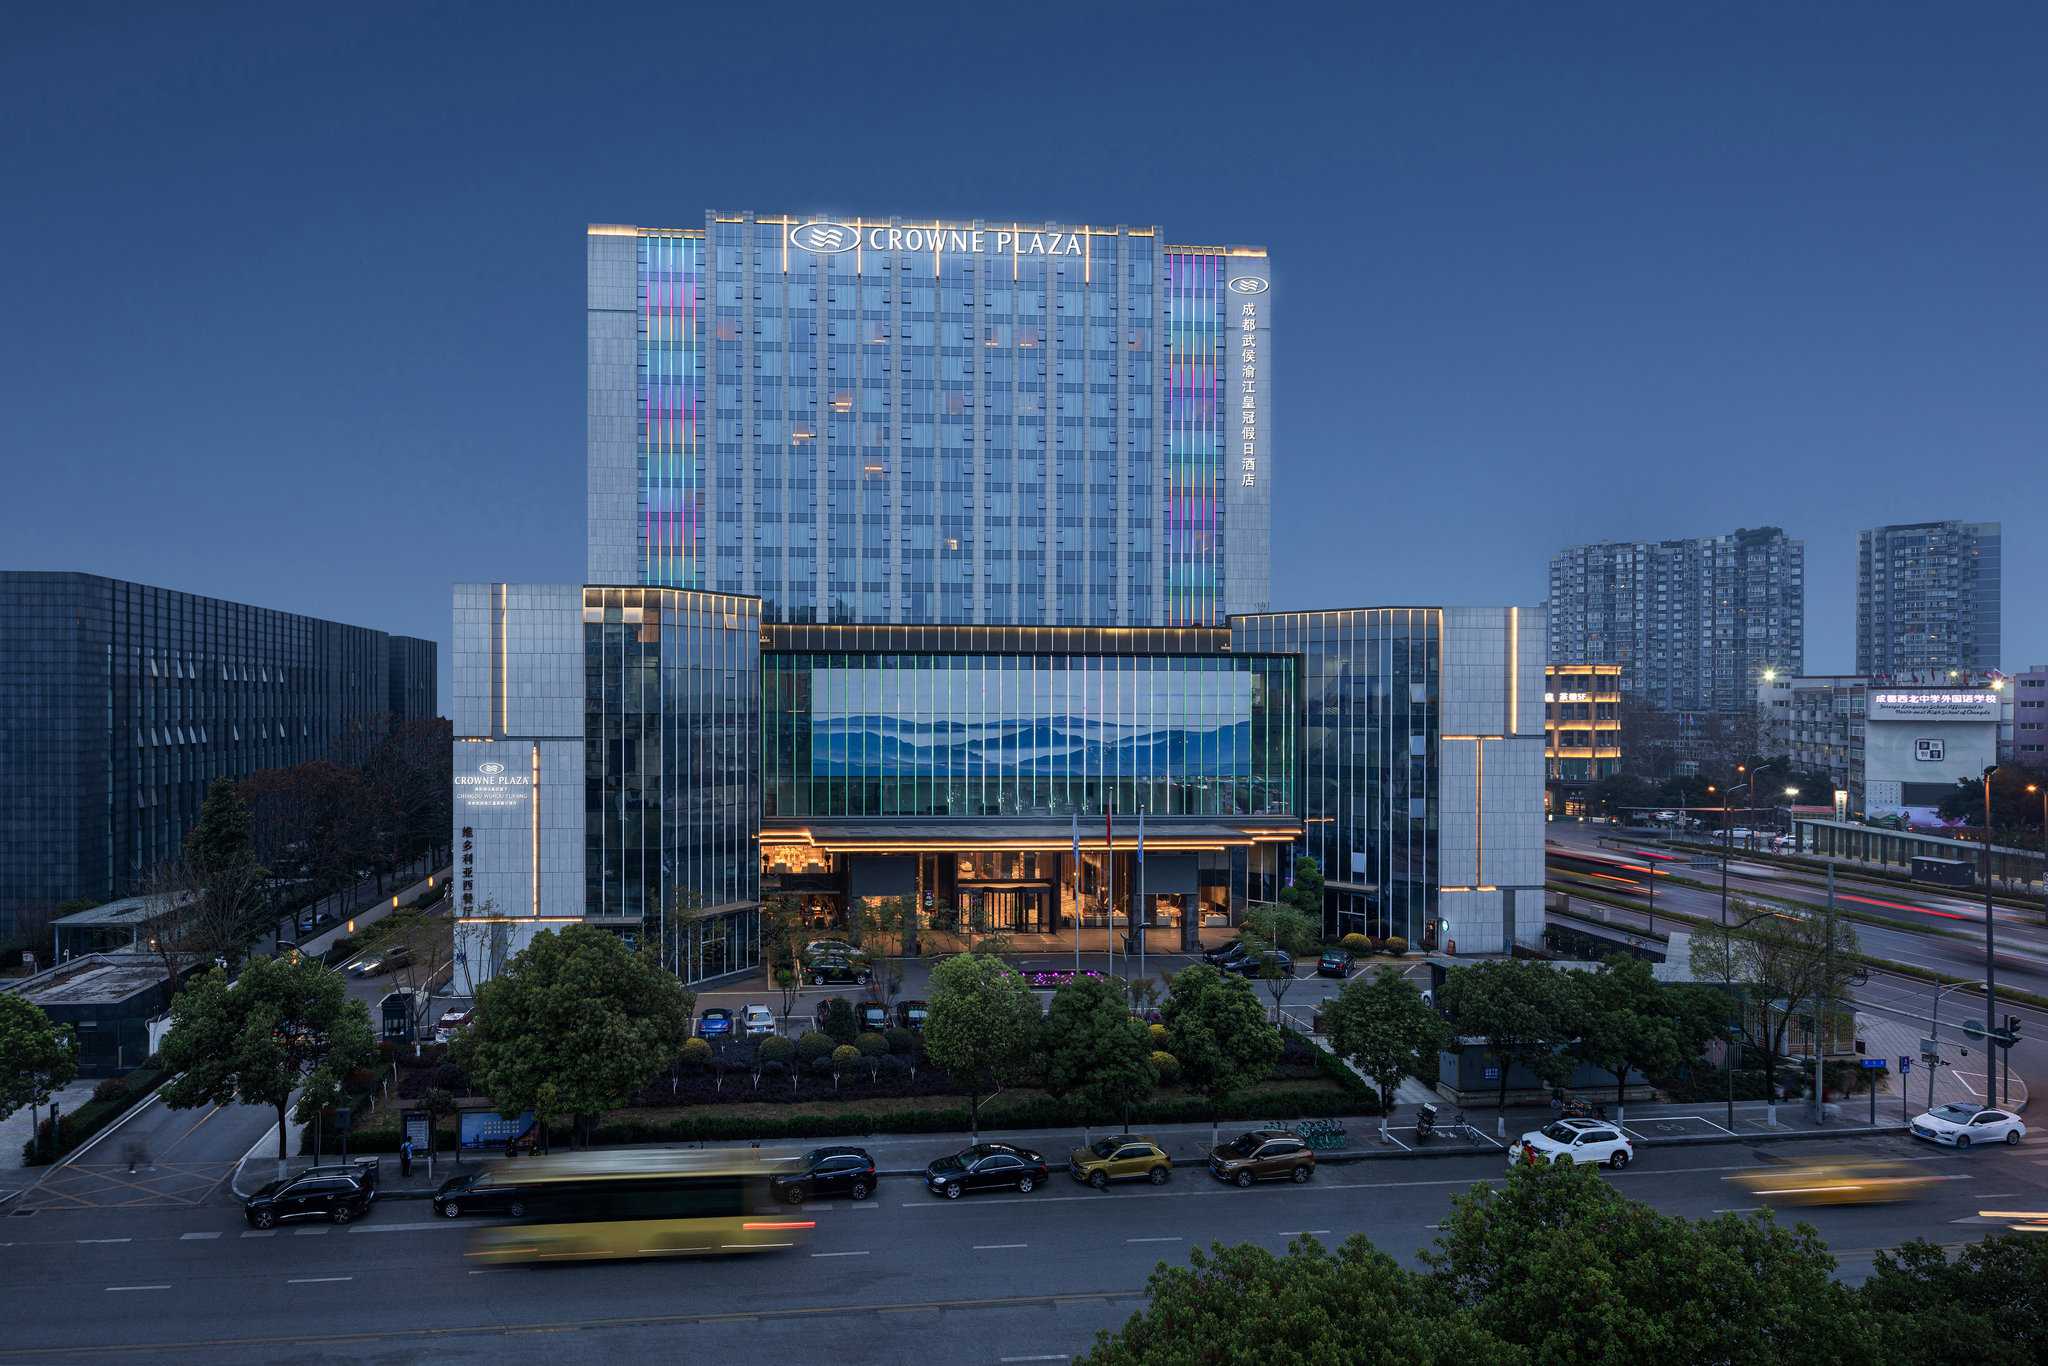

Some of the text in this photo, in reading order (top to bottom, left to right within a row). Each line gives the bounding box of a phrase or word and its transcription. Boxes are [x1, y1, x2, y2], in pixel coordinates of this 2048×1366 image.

[870, 228, 1083, 255] CROWNE PLAZA
[1241, 302, 1256, 487] 成都武侯渝江皇冠假日酒店
[1876, 694, 1997, 703] 成都西北中学外国语学校
[454, 776, 529, 785] CROWNE PLAZA
